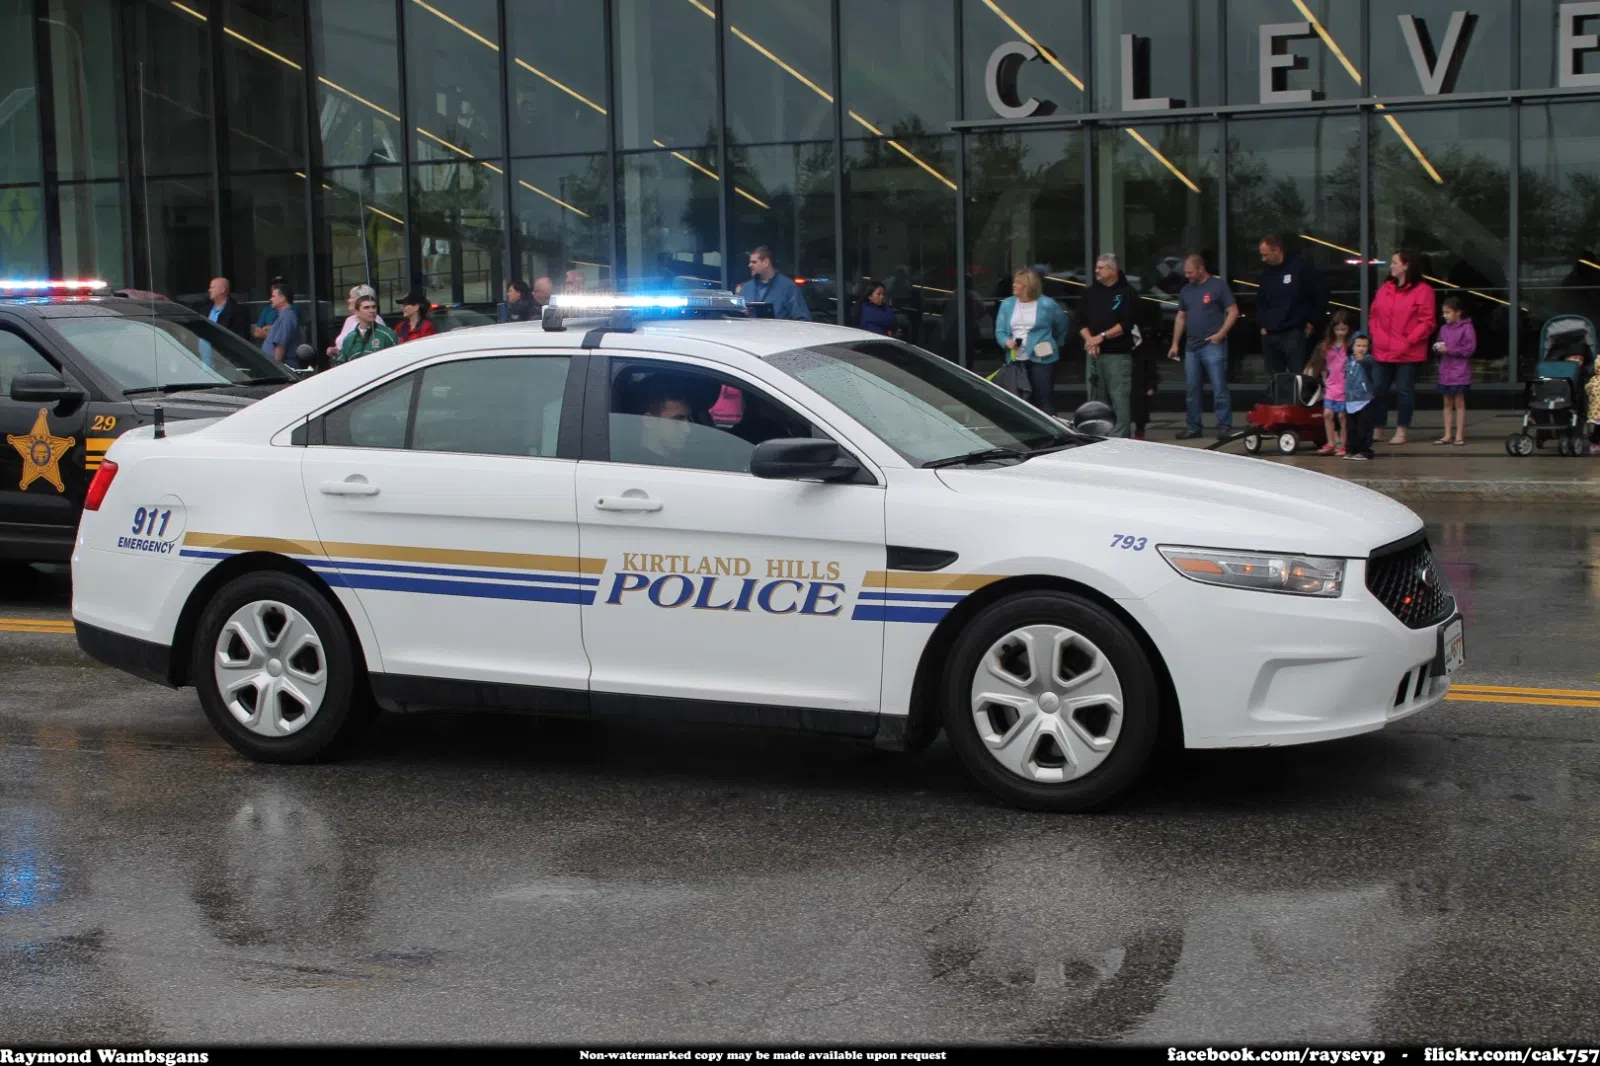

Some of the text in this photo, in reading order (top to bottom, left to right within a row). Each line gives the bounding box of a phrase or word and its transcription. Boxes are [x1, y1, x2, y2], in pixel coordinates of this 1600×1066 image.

[91, 415, 116, 431] 29
[132, 507, 171, 537] 911
[118, 537, 175, 554] EMERGENCY
[1110, 534, 1148, 551] 793
[622, 552, 841, 581] KIRTLAND HILLS
[604, 572, 846, 617] POLICE
